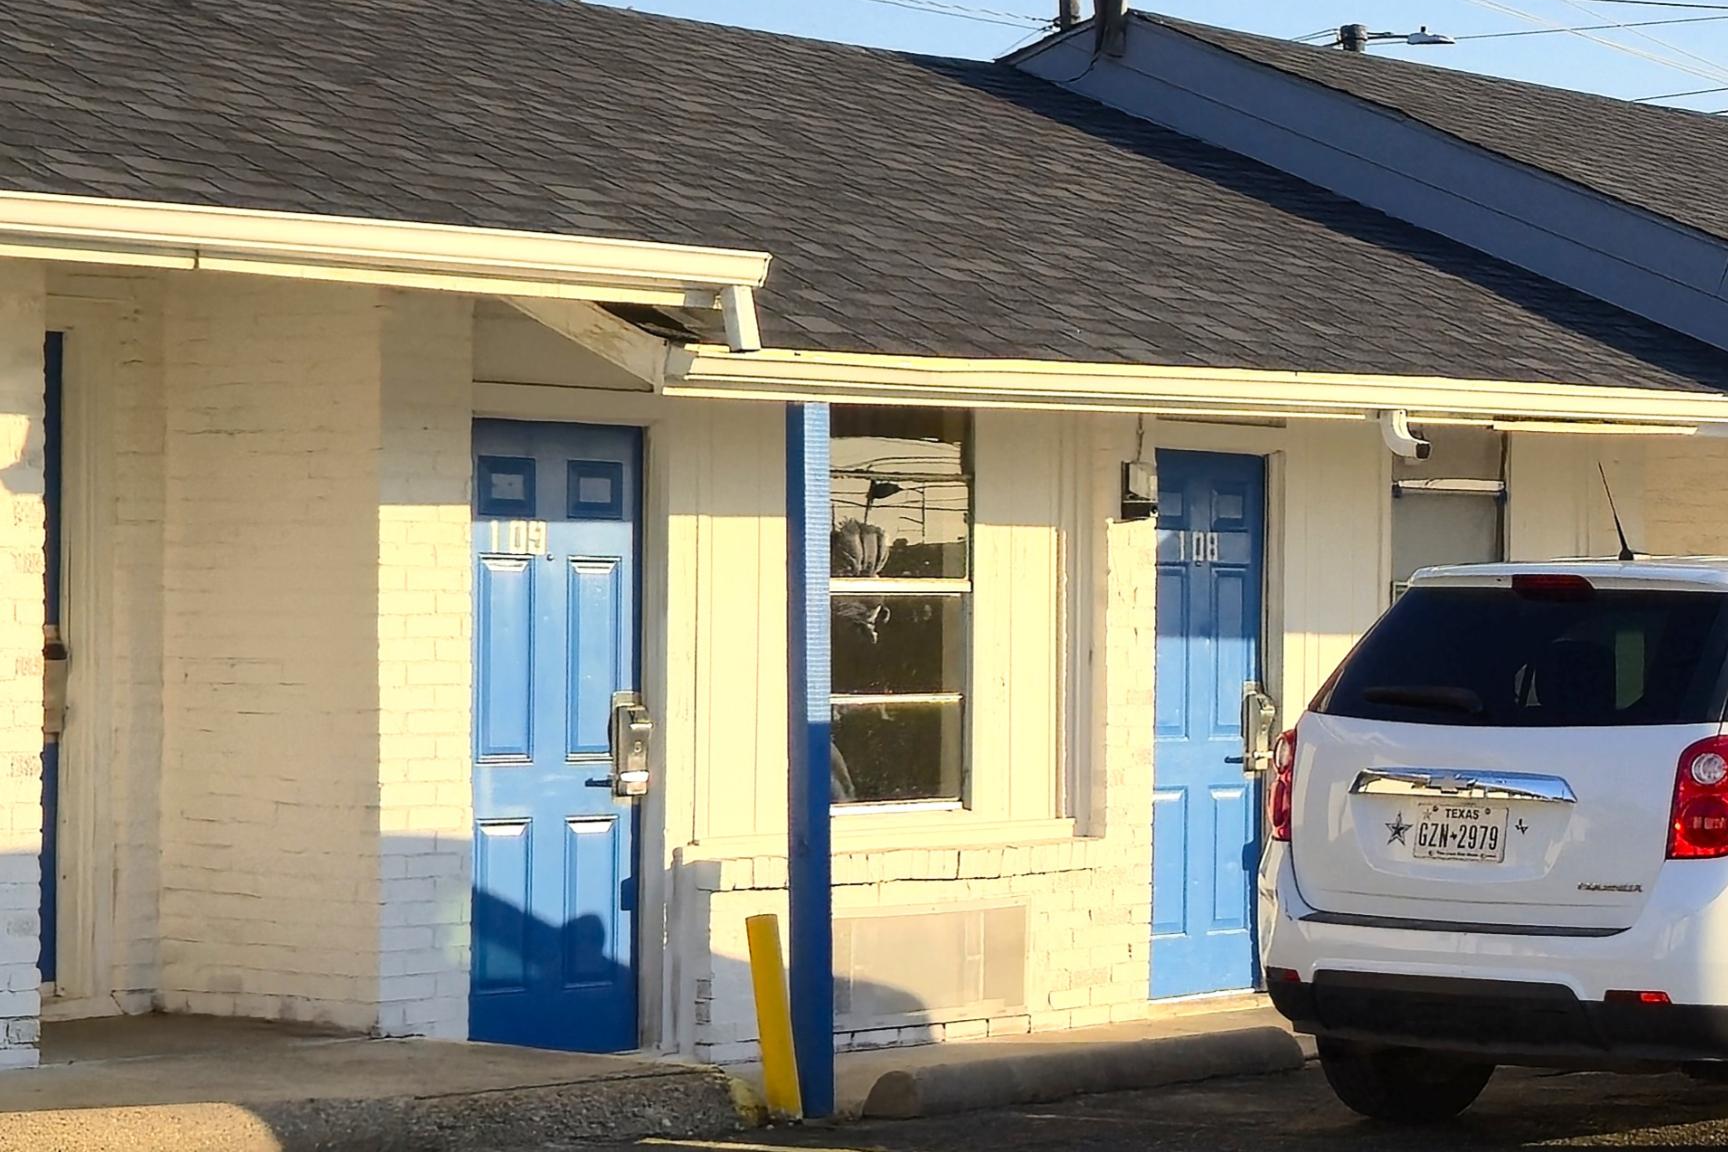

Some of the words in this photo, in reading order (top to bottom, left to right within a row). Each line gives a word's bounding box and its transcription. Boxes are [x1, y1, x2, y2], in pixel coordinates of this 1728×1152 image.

[490, 520, 546, 555] 109
[1180, 531, 1218, 561] 108
[1445, 808, 1480, 820] TEXAS
